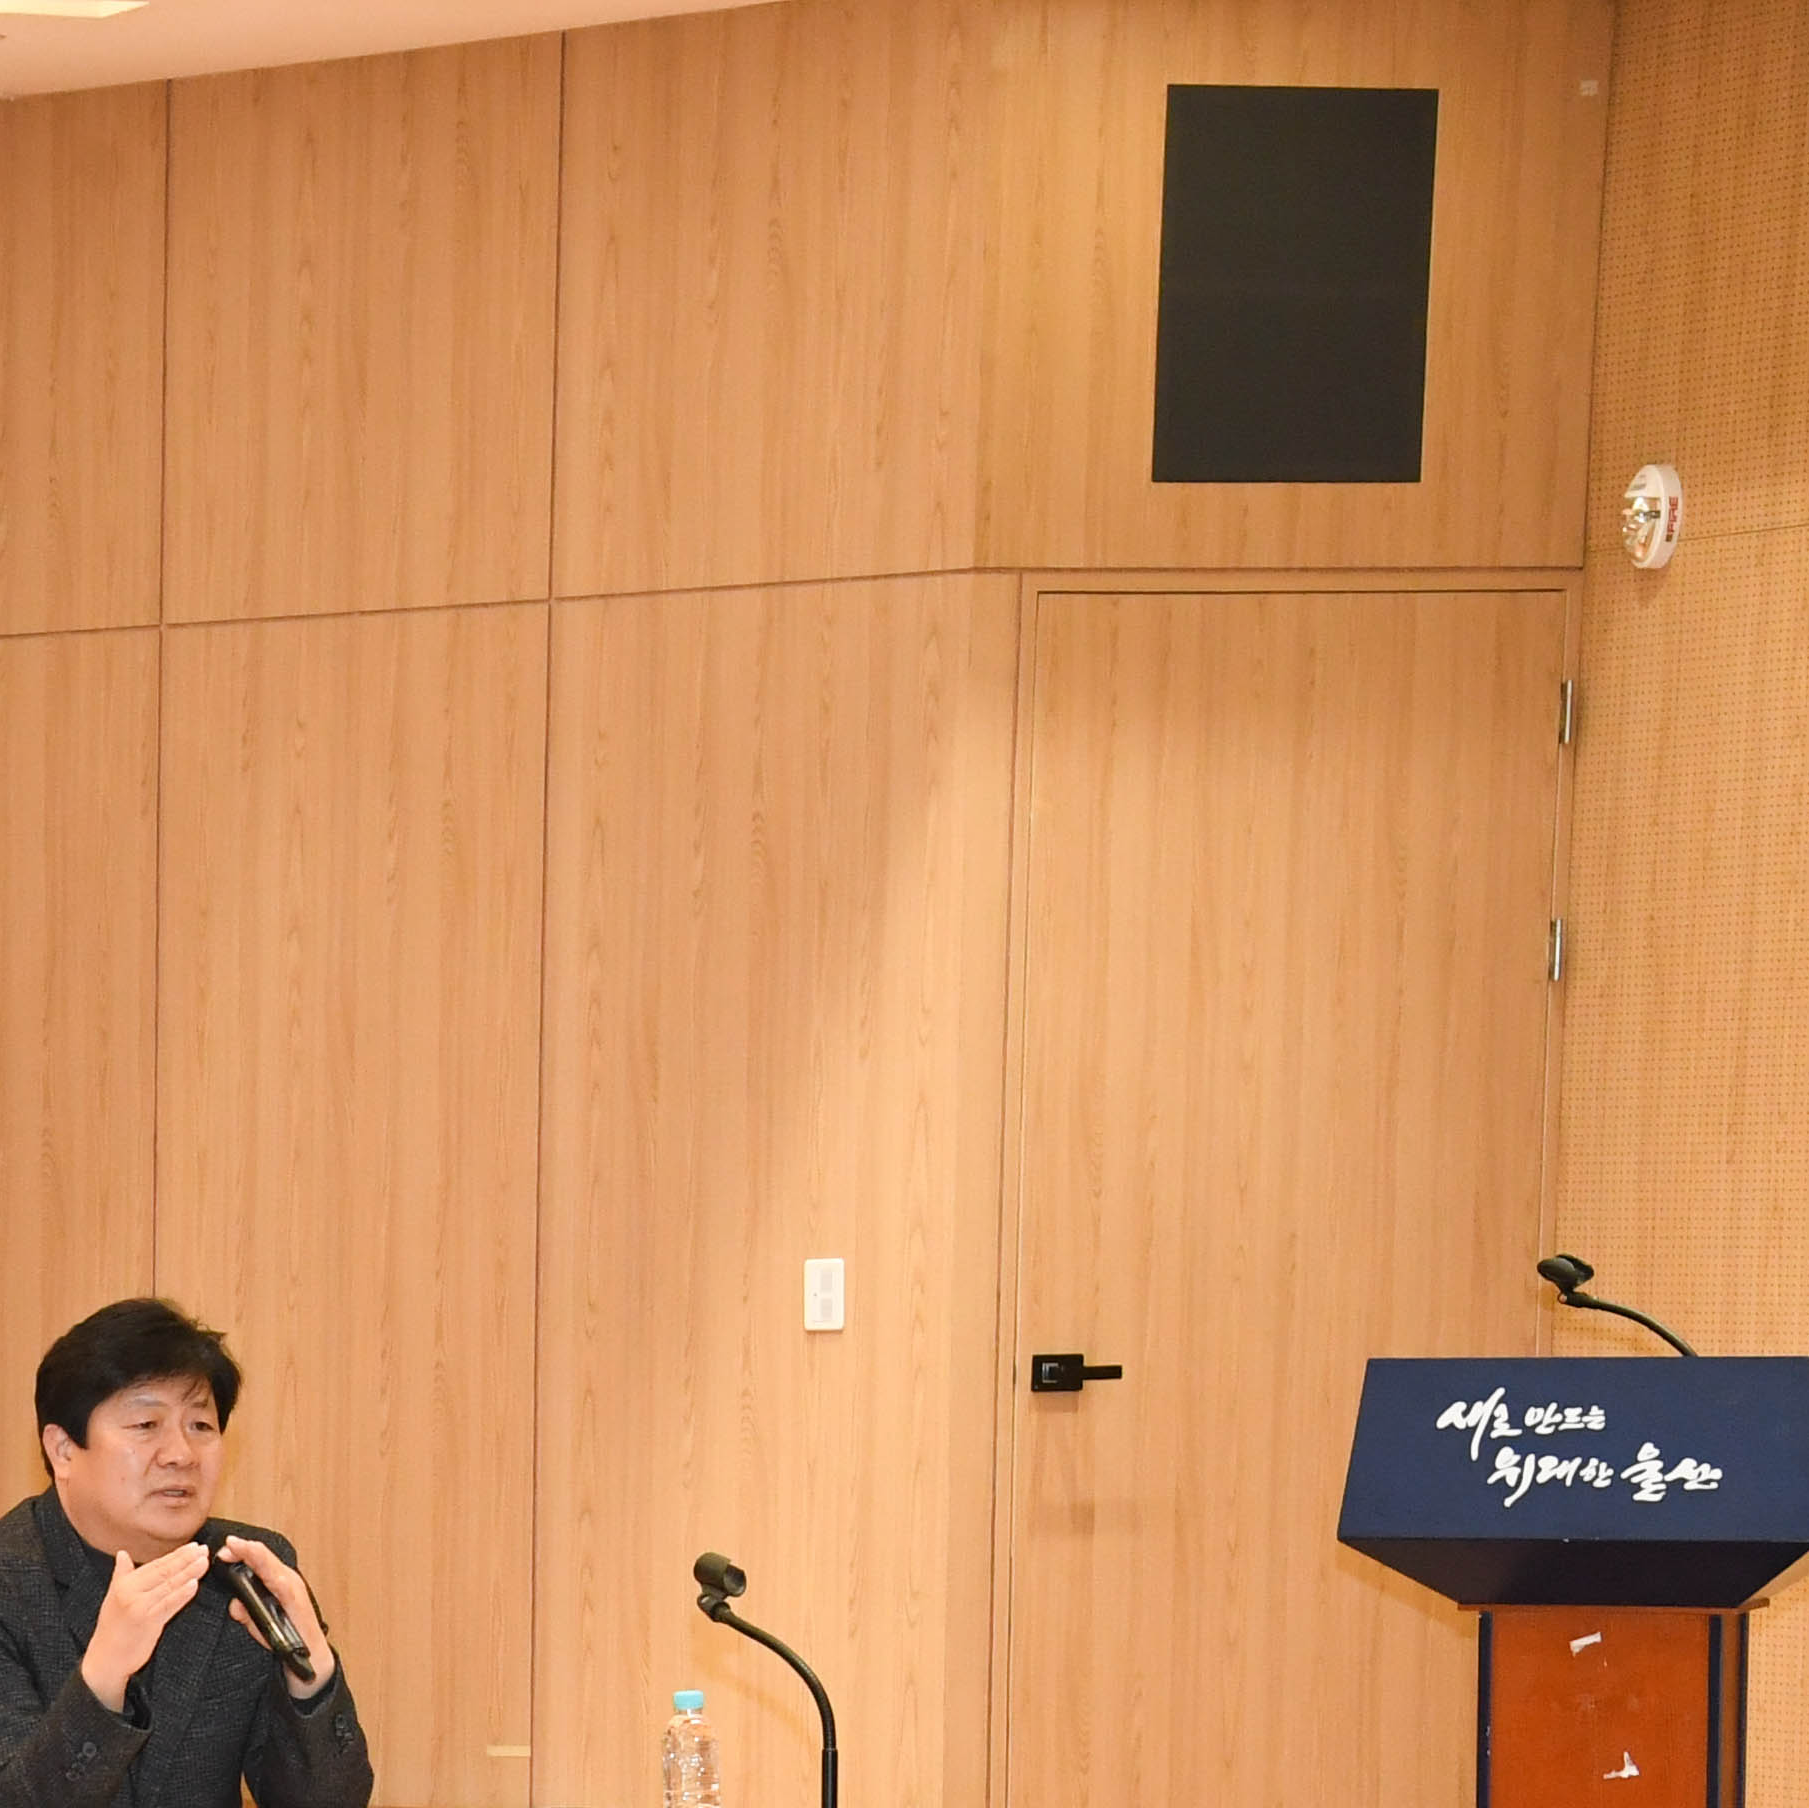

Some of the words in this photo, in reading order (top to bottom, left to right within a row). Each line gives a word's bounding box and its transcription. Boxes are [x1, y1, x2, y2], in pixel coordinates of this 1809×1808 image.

[1436, 1387, 1522, 1461] 새로
[1524, 1402, 1606, 1435] 만드는
[1486, 1446, 1614, 1508] 위대한
[1620, 1442, 1723, 1502] 울산
